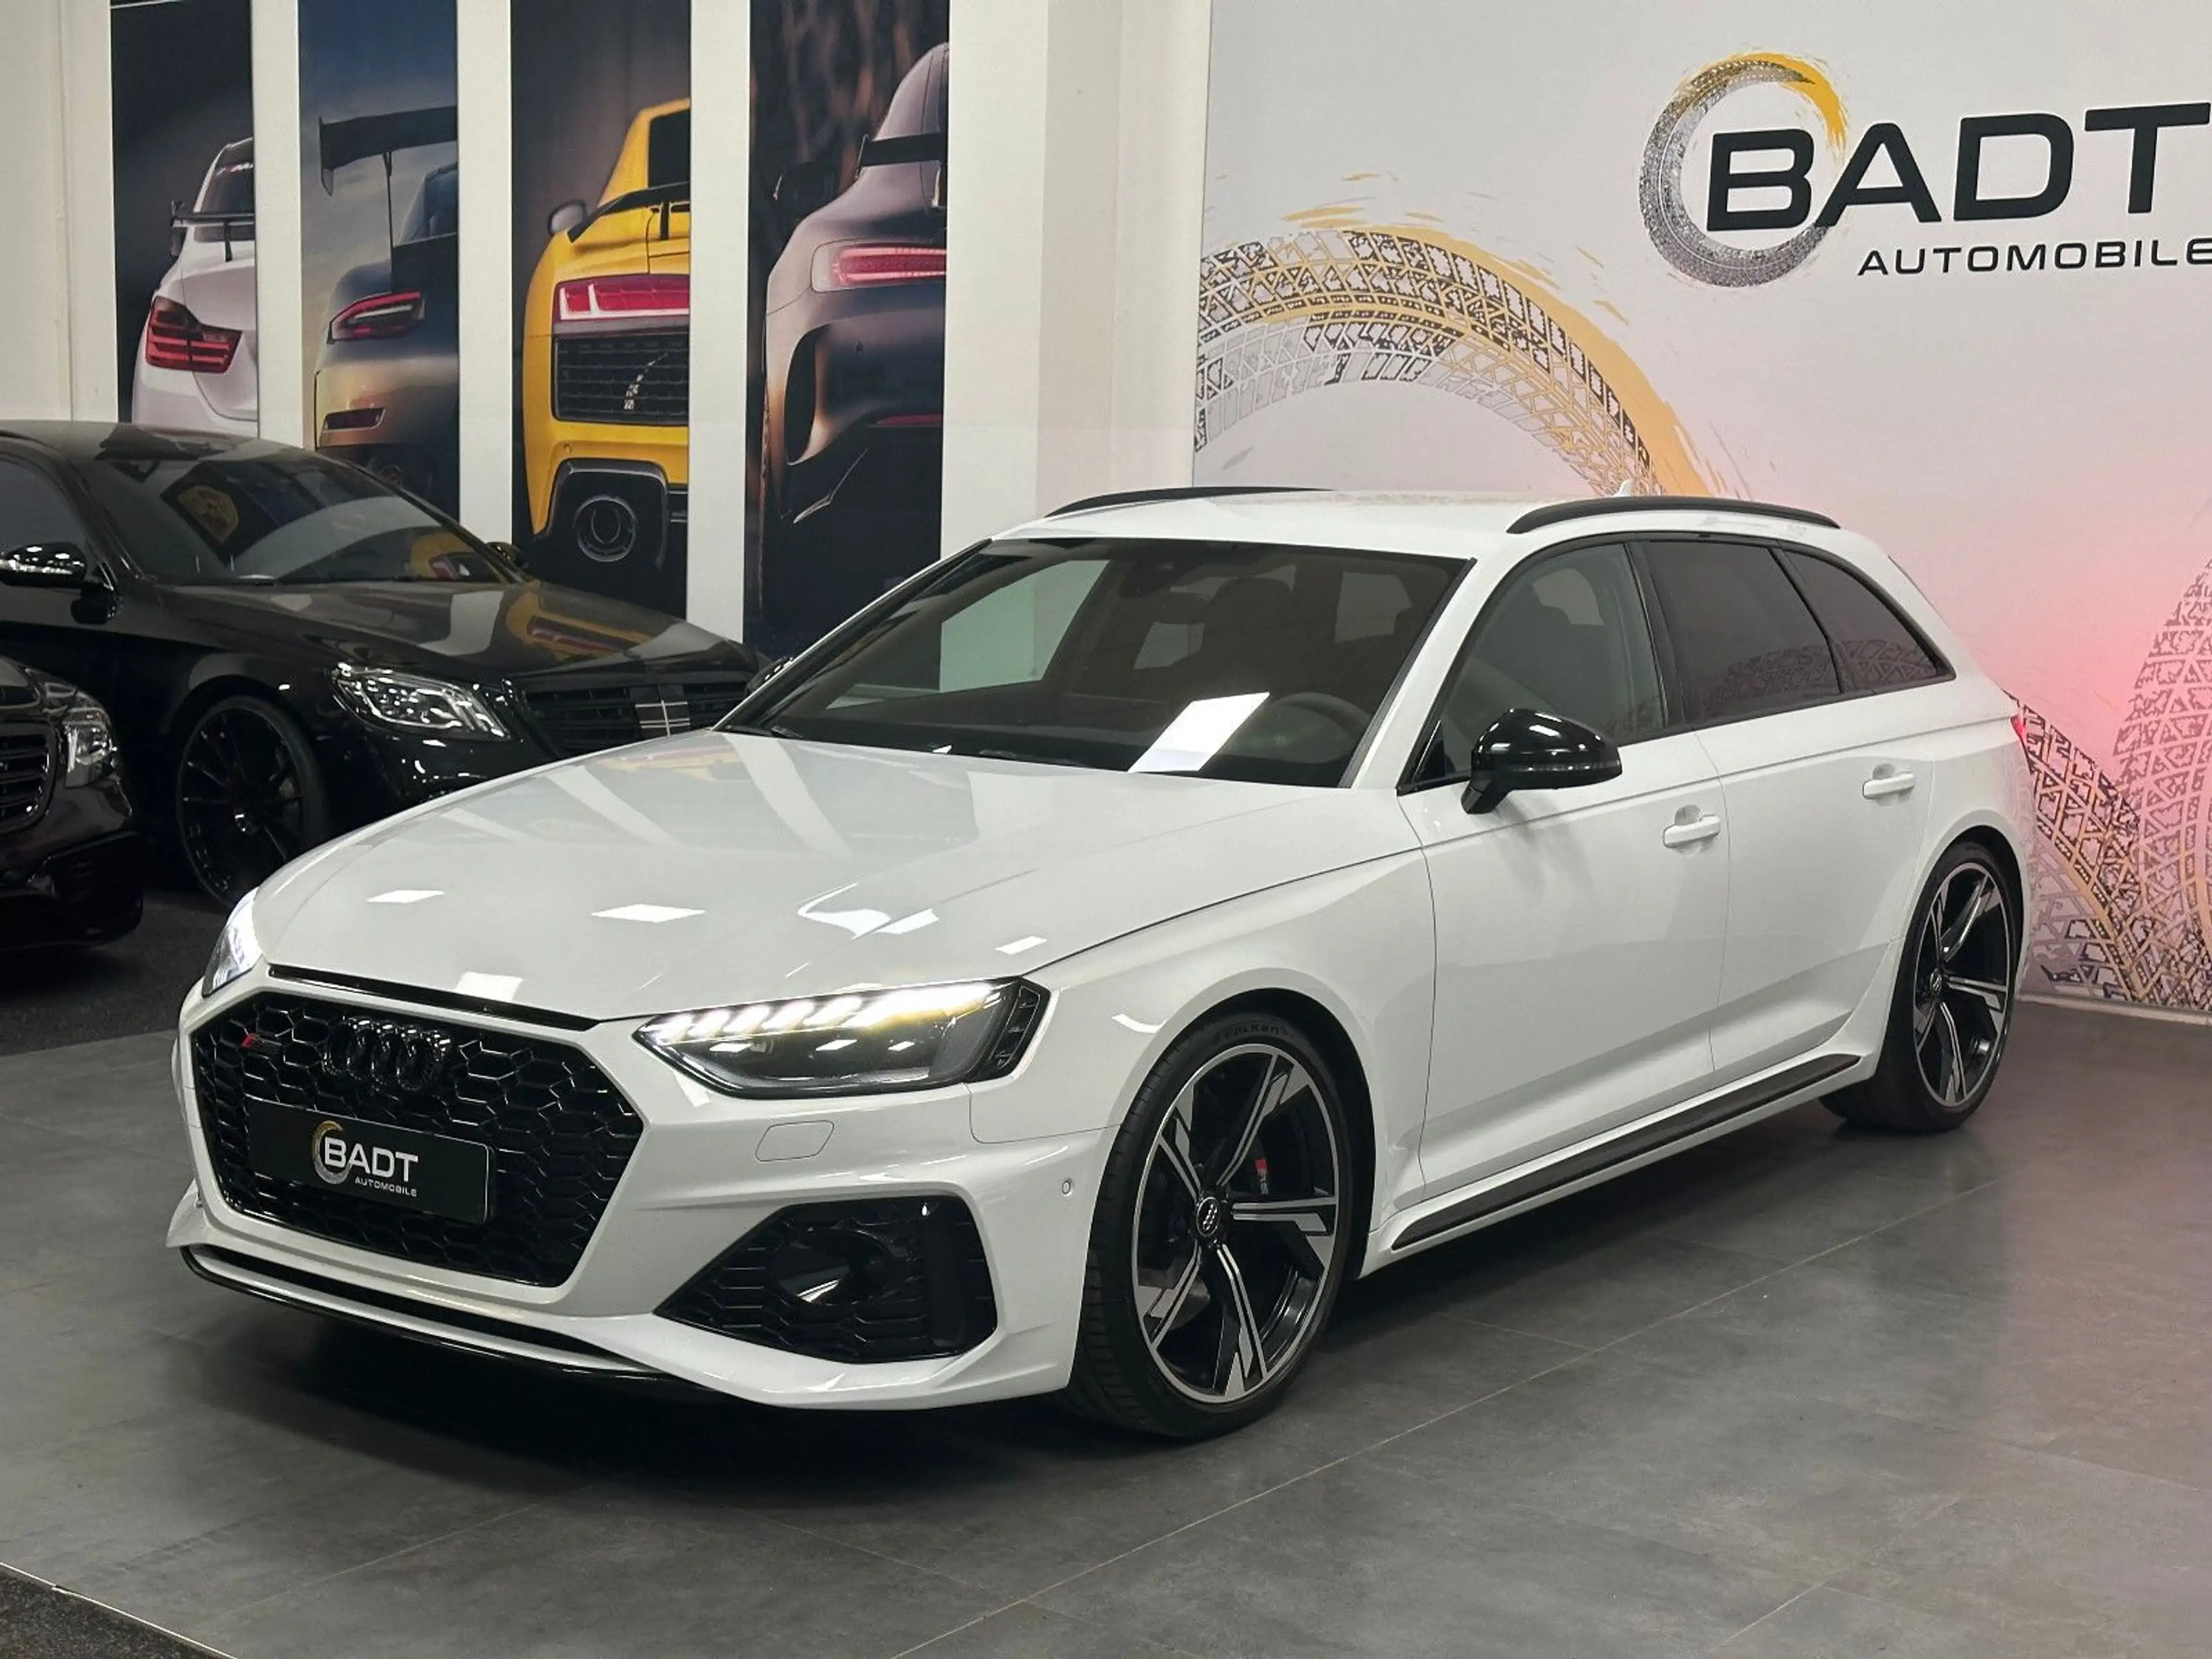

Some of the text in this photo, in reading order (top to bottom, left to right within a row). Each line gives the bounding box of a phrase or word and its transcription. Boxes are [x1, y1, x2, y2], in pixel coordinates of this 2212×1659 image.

[1706, 102, 2211, 232] BADT
[1858, 237, 2212, 276] AUTOMOBILE
[324, 1137, 419, 1183] BADT
[355, 1176, 418, 1197] AUTOMOBILE
